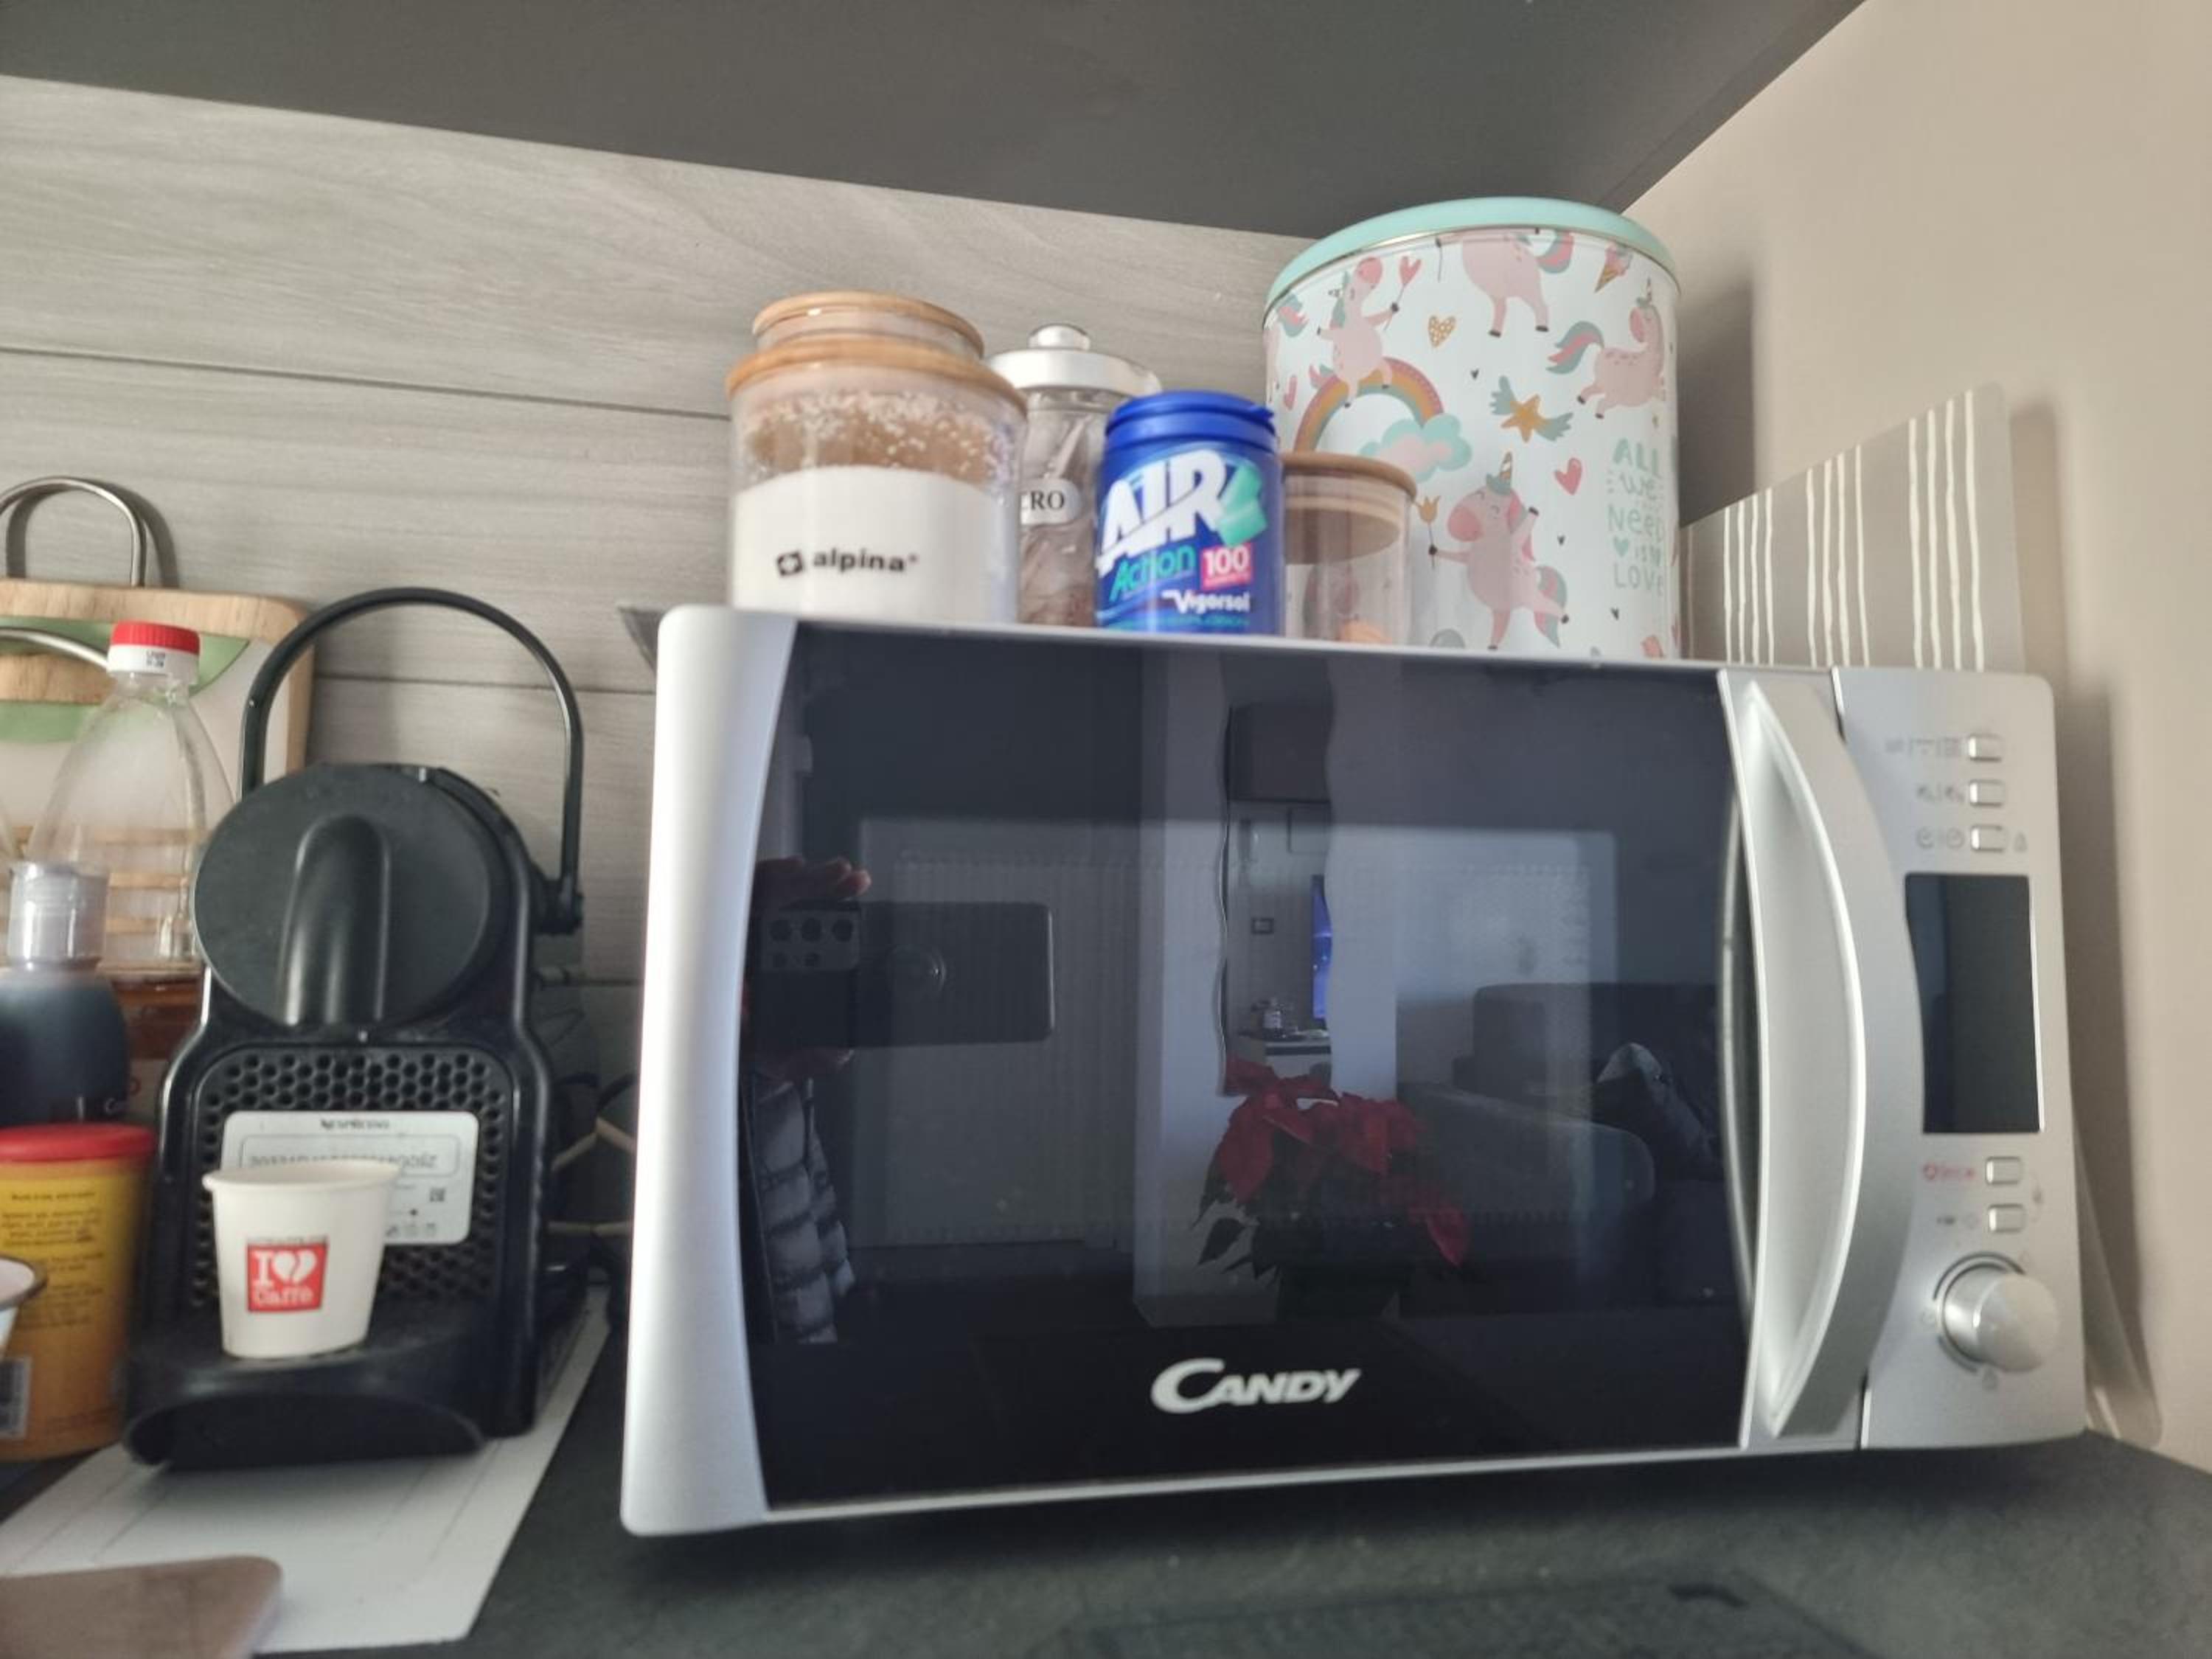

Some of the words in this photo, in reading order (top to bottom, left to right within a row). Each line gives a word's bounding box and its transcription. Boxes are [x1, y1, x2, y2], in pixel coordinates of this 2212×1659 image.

[1613, 437, 1663, 479] ALL
[1021, 490, 1065, 510] RO
[1096, 449, 1226, 578] AIR
[1109, 544, 1196, 602] Action
[1203, 546, 1250, 578] 100
[252, 1249, 274, 1287] I
